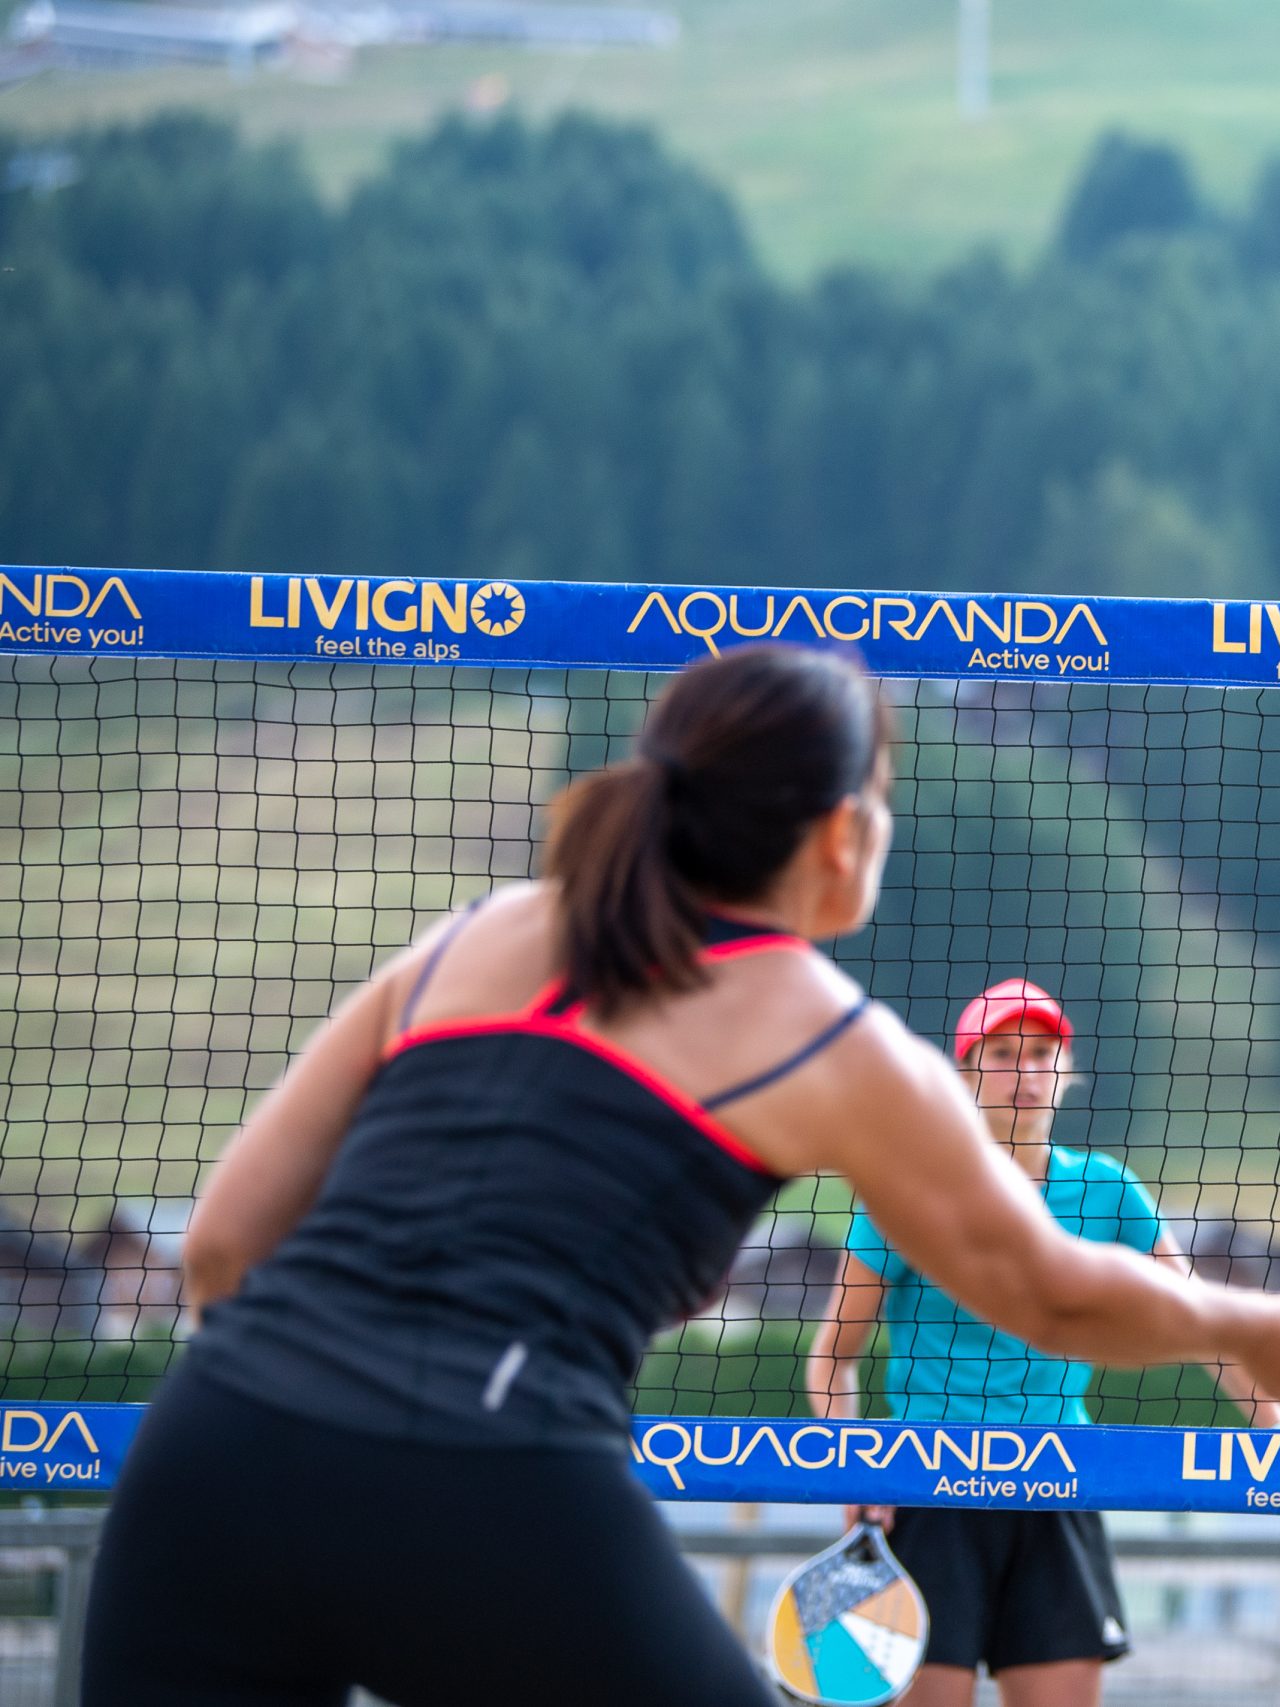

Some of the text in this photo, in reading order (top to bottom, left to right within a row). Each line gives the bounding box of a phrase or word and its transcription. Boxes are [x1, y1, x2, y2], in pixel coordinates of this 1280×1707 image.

[251, 576, 527, 637] LIVIGNO
[0, 622, 144, 649] Active you!
[627, 591, 1108, 661] AQUAGRANDA
[315, 635, 461, 664] feel the alps
[967, 647, 1110, 676] Active you!
[44, 1459, 100, 1484] you!
[933, 1475, 1078, 1503] Active you!
